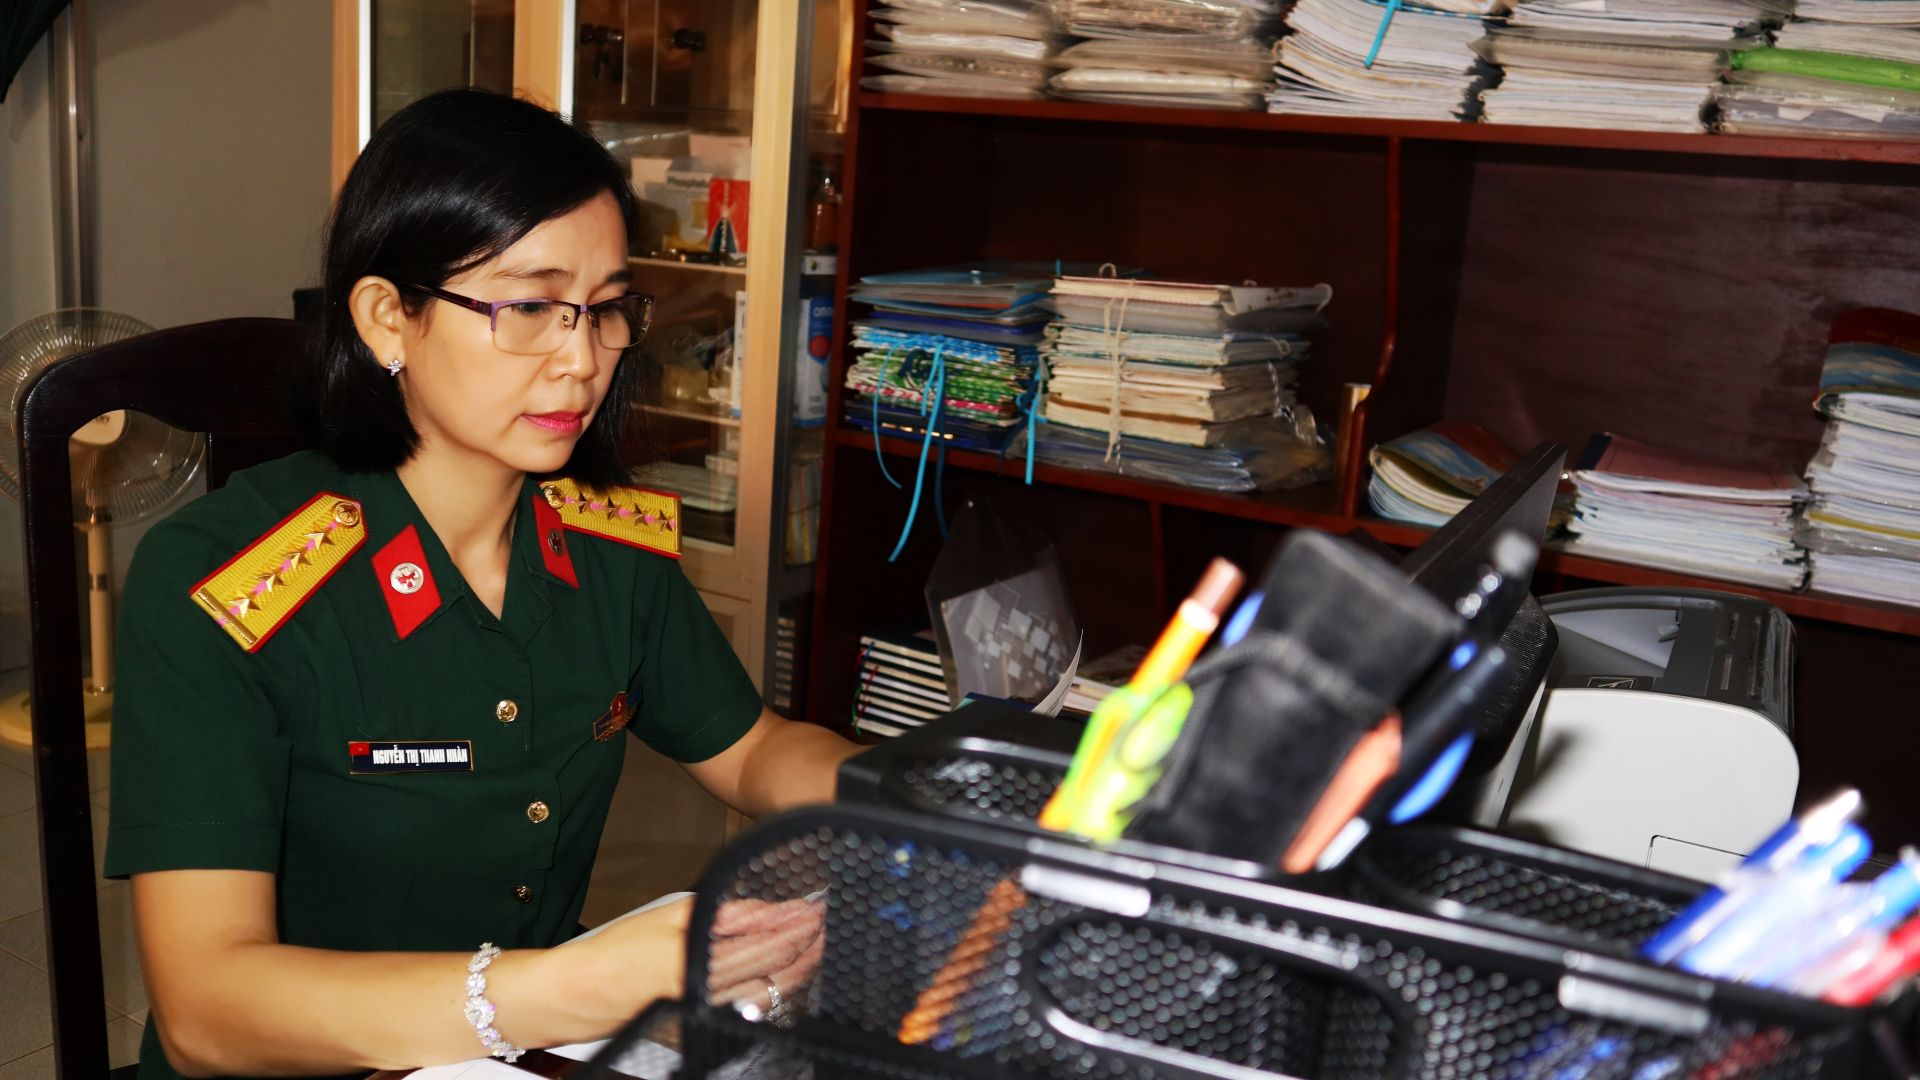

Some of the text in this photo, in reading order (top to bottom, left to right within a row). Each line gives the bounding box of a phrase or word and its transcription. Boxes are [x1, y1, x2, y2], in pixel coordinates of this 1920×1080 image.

[372, 744, 405, 765] NGUYỄN
[405, 749, 420, 767] THỊ
[420, 749, 446, 763] THANH
